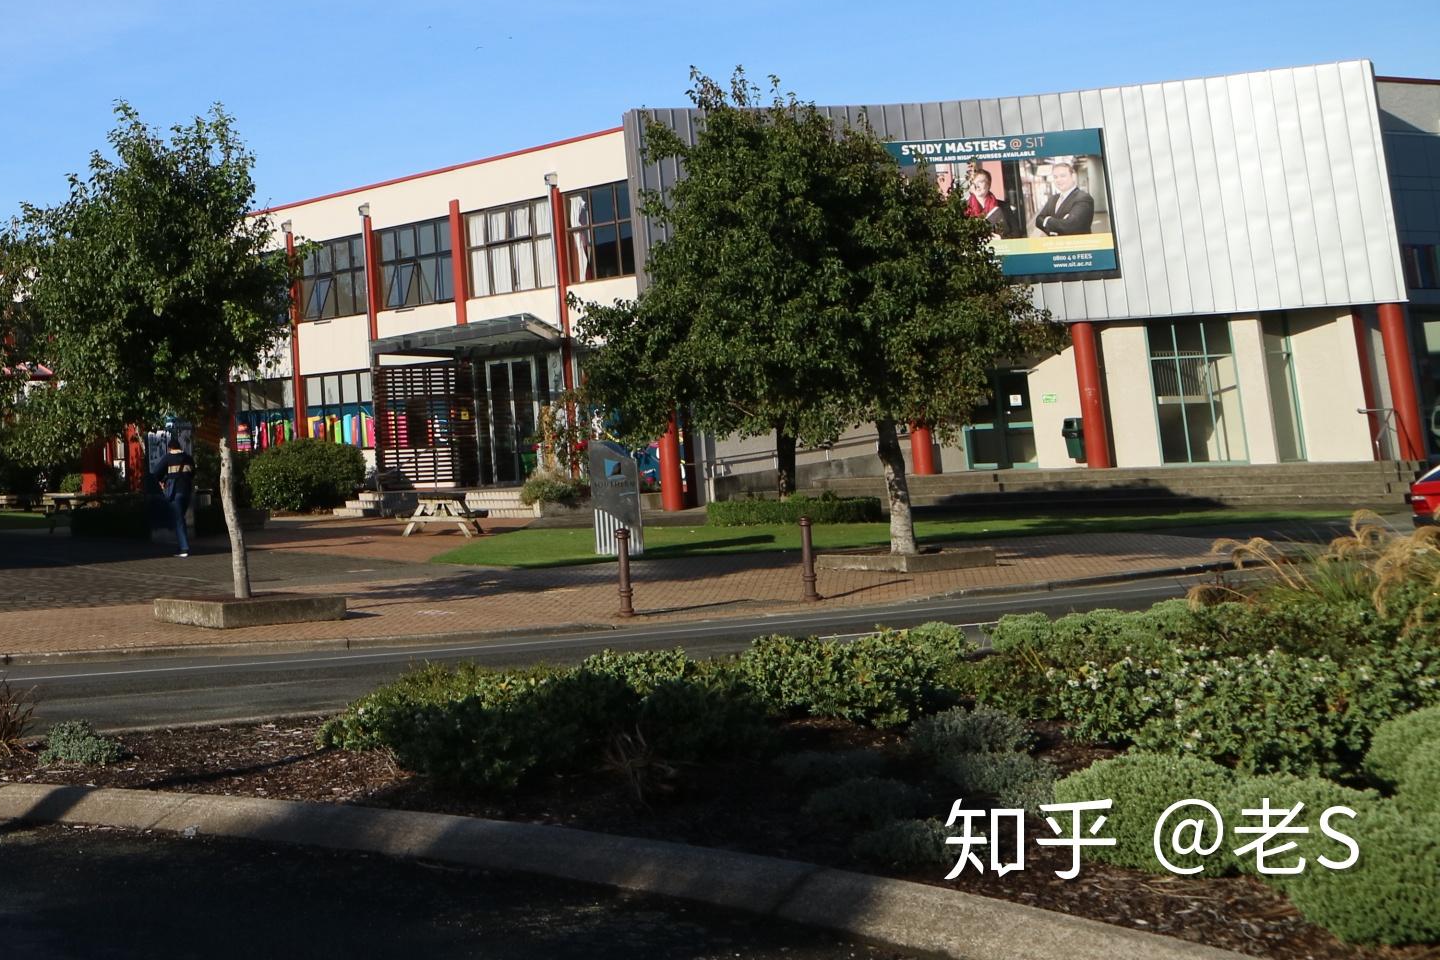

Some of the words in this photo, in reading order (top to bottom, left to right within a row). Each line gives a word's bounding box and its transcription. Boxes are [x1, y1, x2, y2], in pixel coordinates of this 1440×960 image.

[901, 143, 942, 155] STUDY
[945, 140, 1006, 154] MASTERS
[1009, 139, 1022, 150] @
[1026, 137, 1045, 148] SIT
[1002, 150, 1036, 158] AVAILABLE
